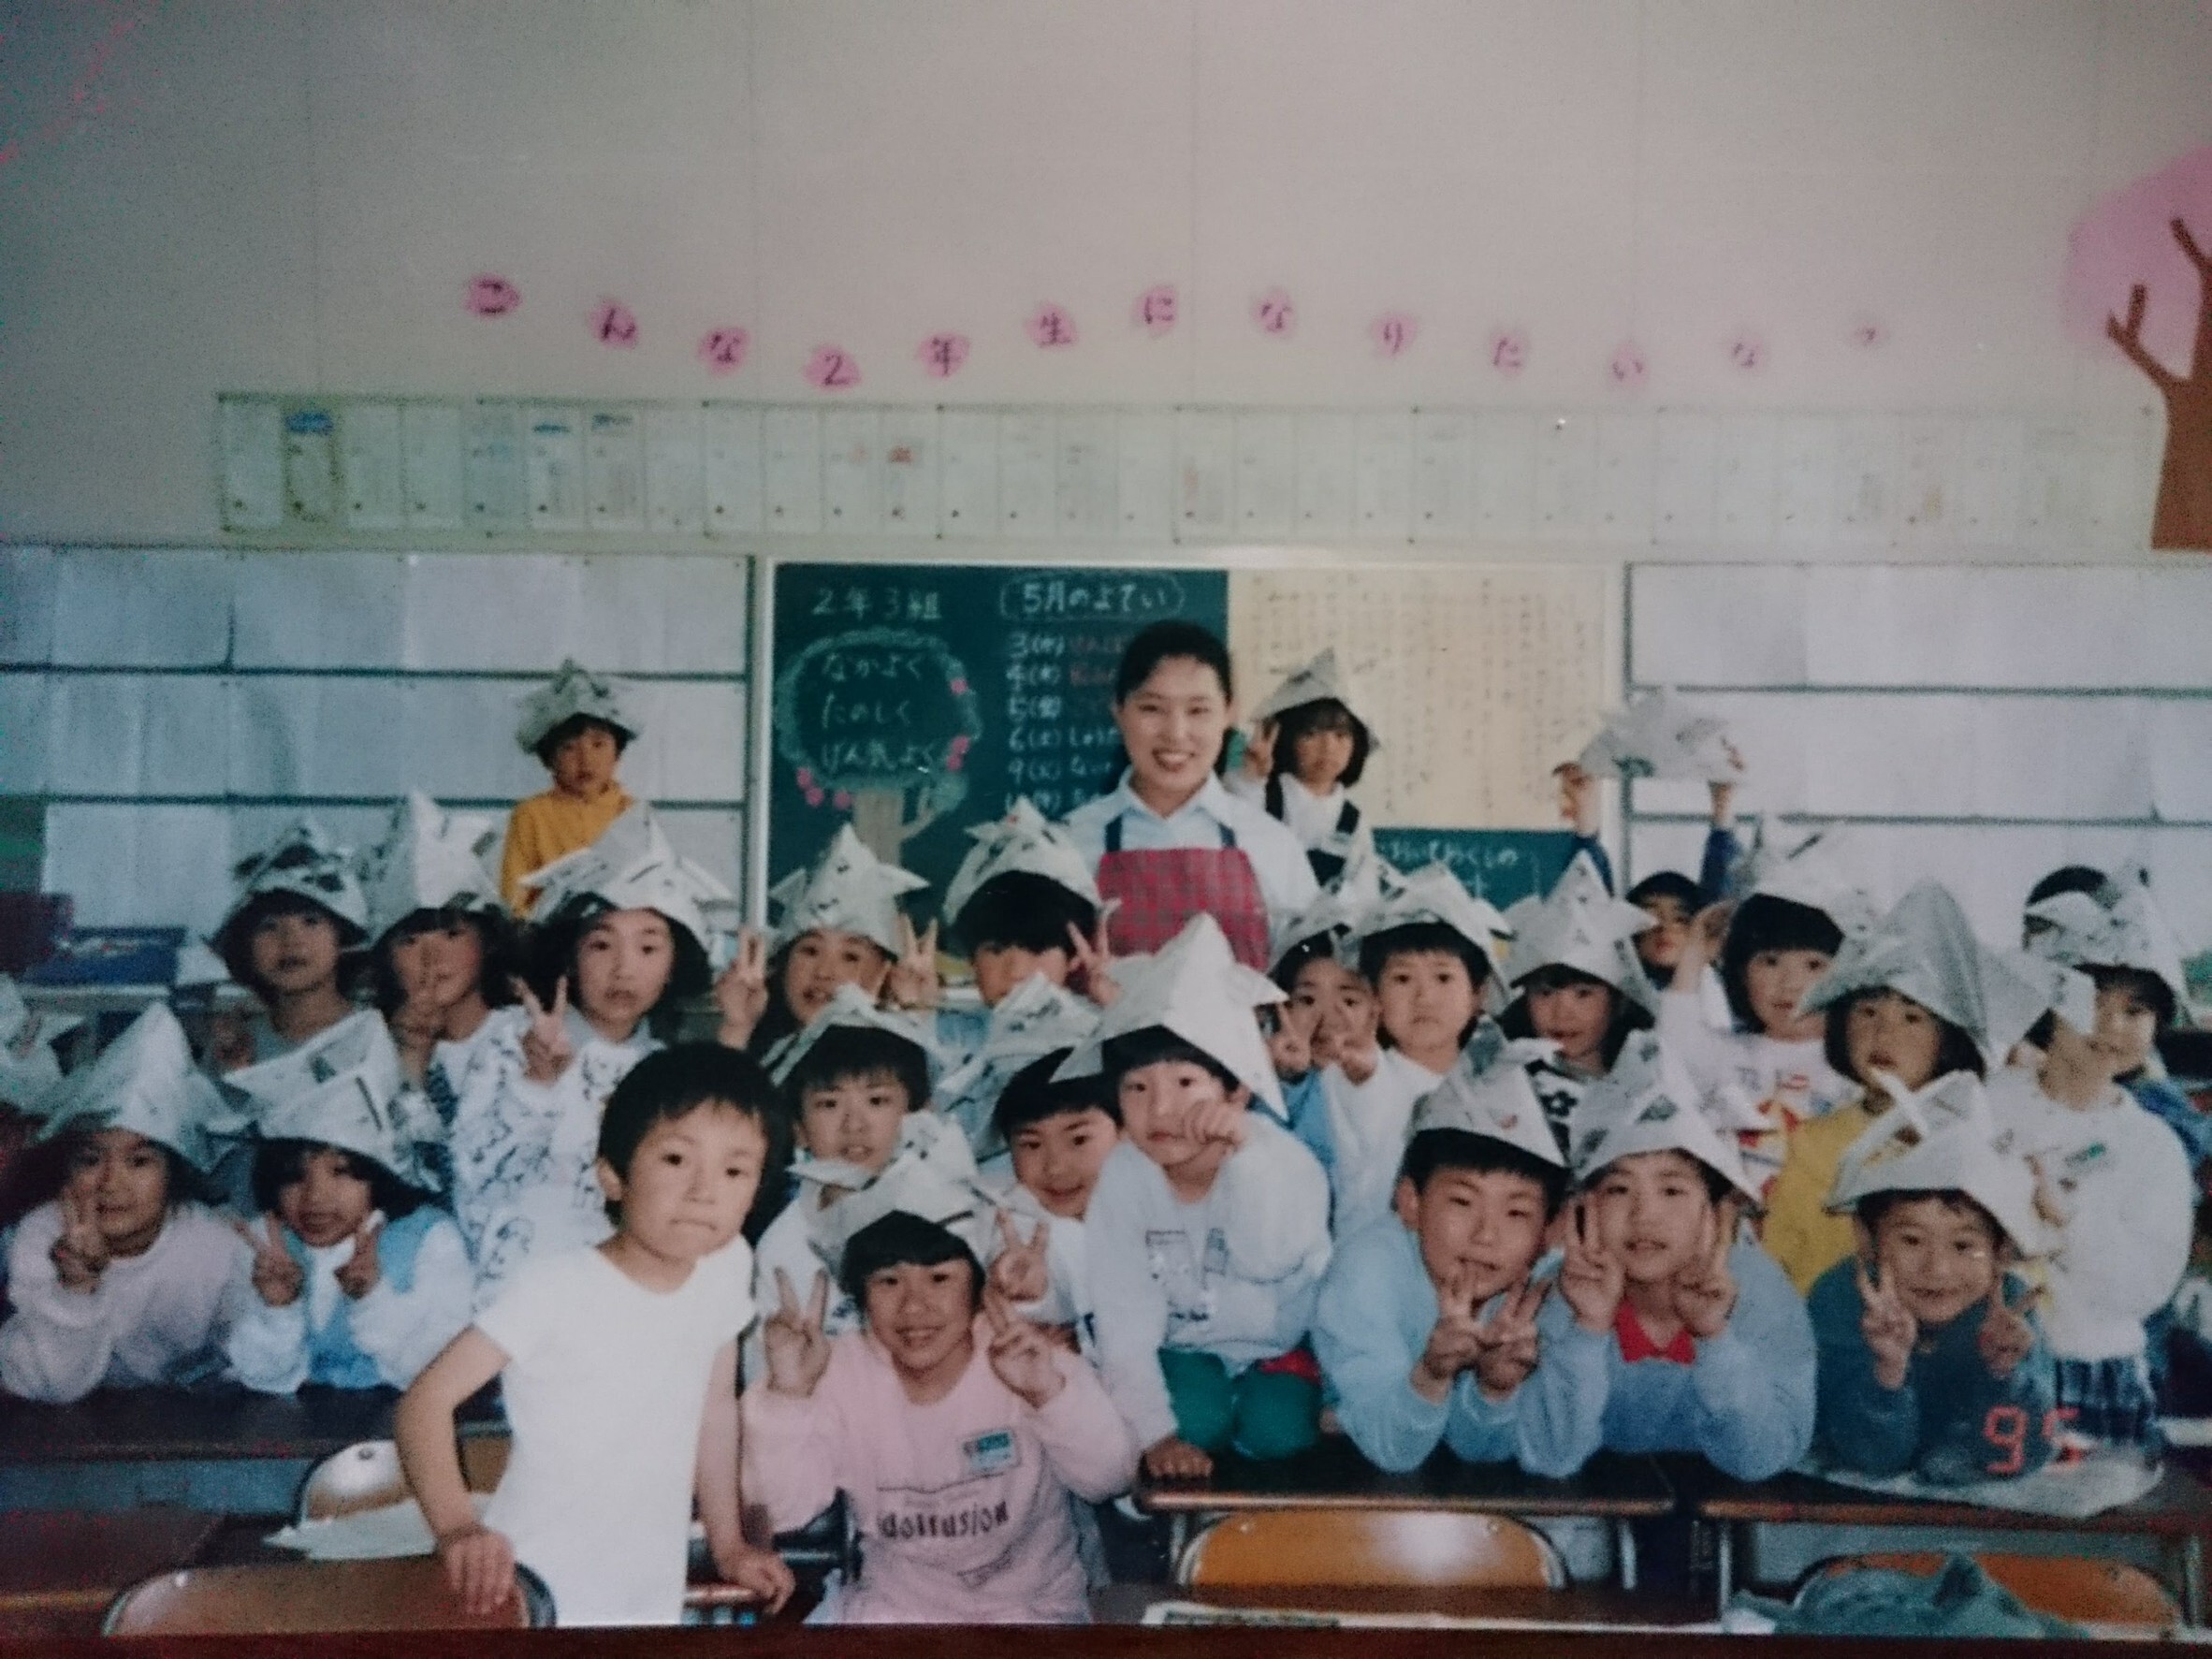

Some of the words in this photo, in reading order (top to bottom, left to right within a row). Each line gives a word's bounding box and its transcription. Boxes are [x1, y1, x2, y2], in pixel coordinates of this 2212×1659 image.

[811, 587, 942, 620] 2年3組
[1023, 580, 1168, 613] 5月のよてい
[822, 652, 924, 682] なかよく
[821, 690, 911, 729] たのしく
